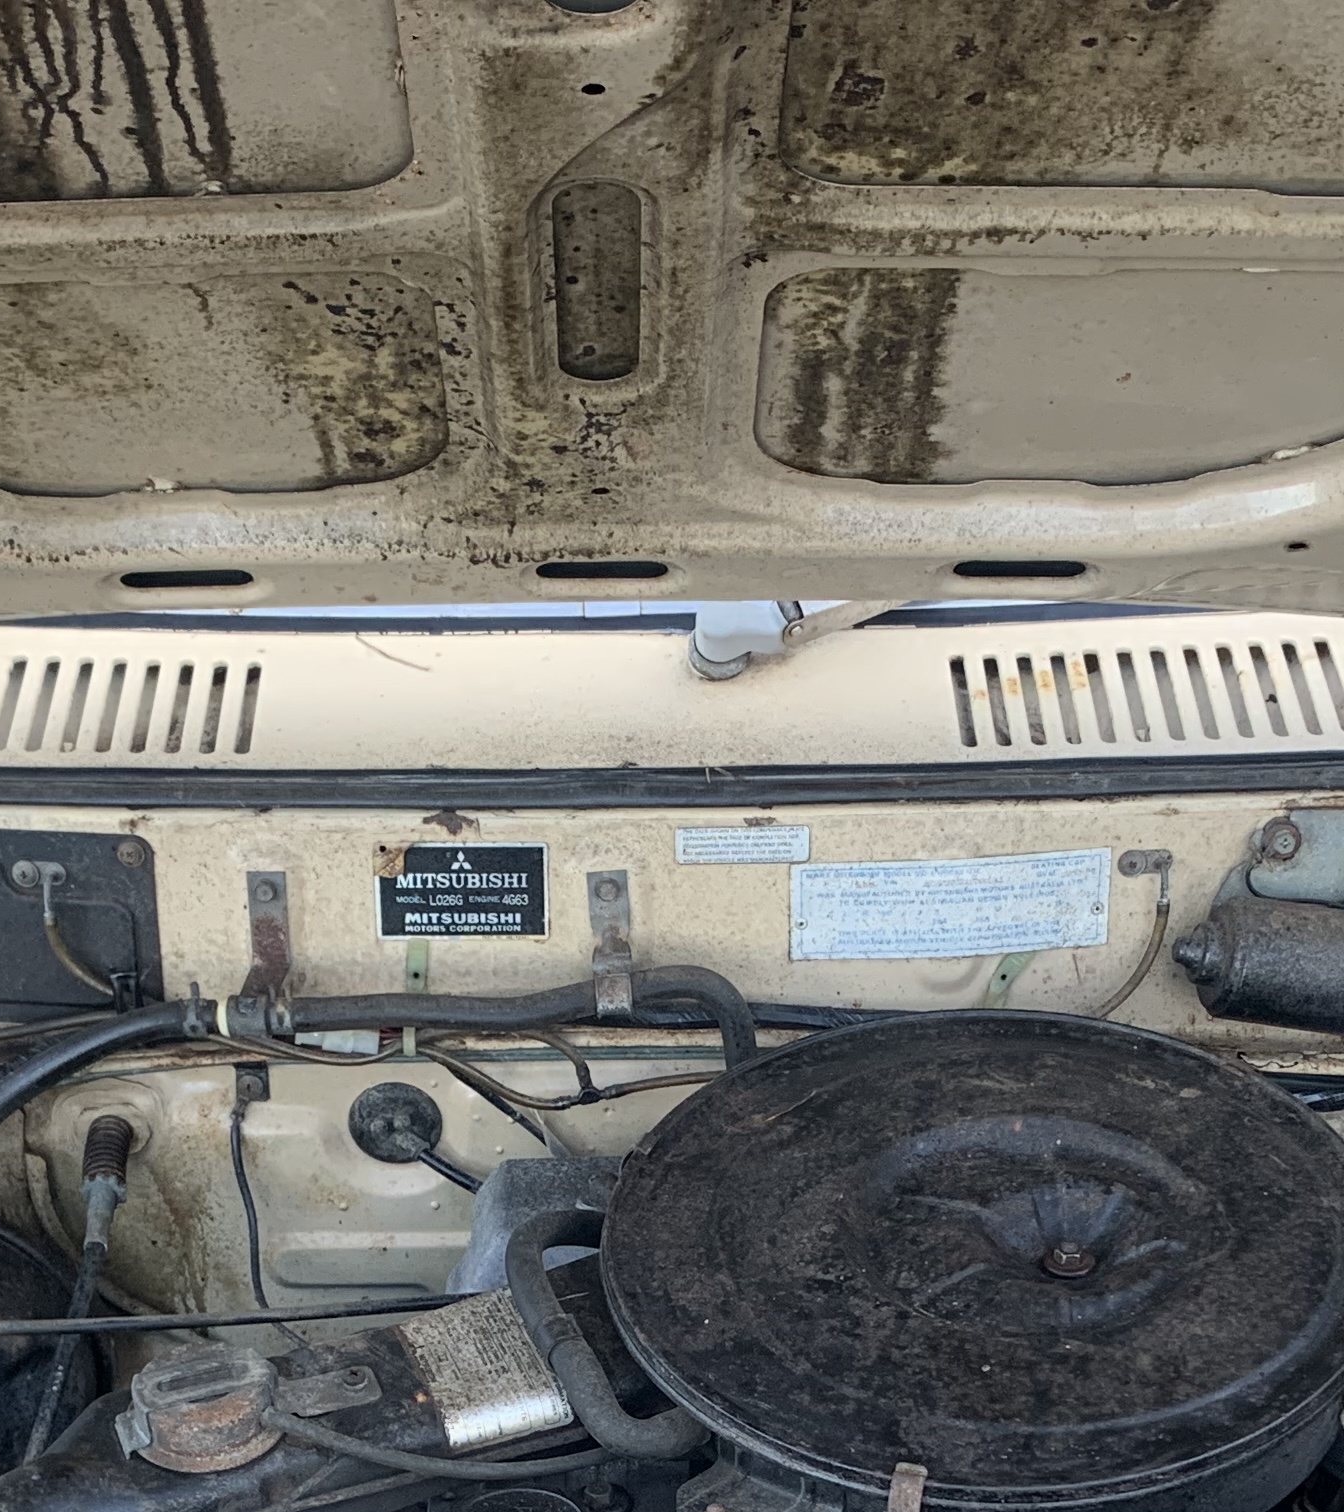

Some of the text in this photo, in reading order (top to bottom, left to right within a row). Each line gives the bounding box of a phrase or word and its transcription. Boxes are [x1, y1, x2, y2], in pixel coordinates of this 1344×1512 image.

[396, 873, 528, 888] MITSUBISHI
[396, 896, 426, 904] MODEL
[502, 894, 528, 905] 4G63
[405, 913, 521, 924] MITSUBISHI
